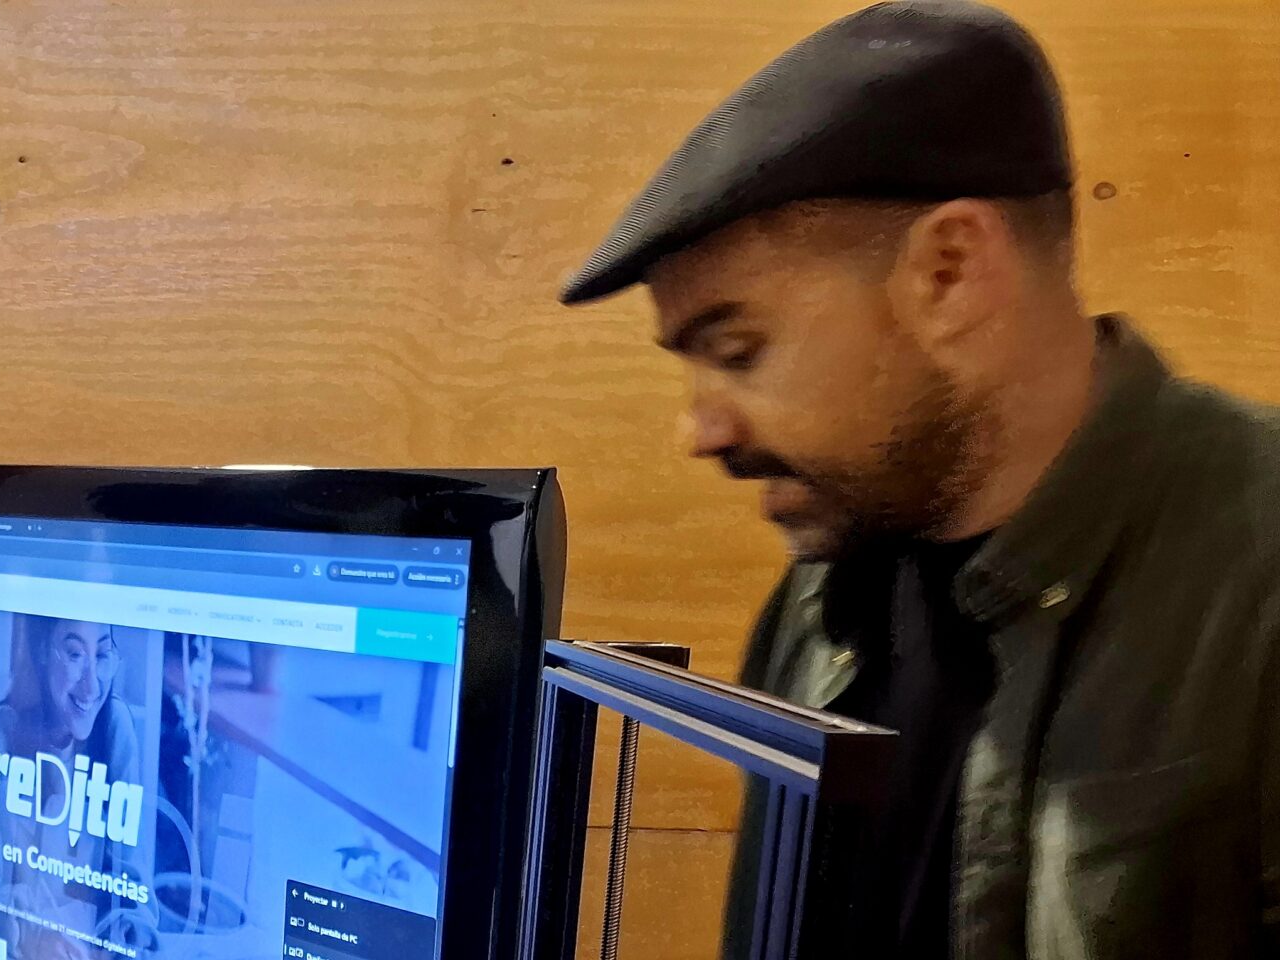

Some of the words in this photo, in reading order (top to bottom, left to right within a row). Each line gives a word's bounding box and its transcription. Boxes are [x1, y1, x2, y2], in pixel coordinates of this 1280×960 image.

[3, 844, 23, 865] en
[26, 846, 149, 904] Competencias
[349, 934, 358, 945] PC
